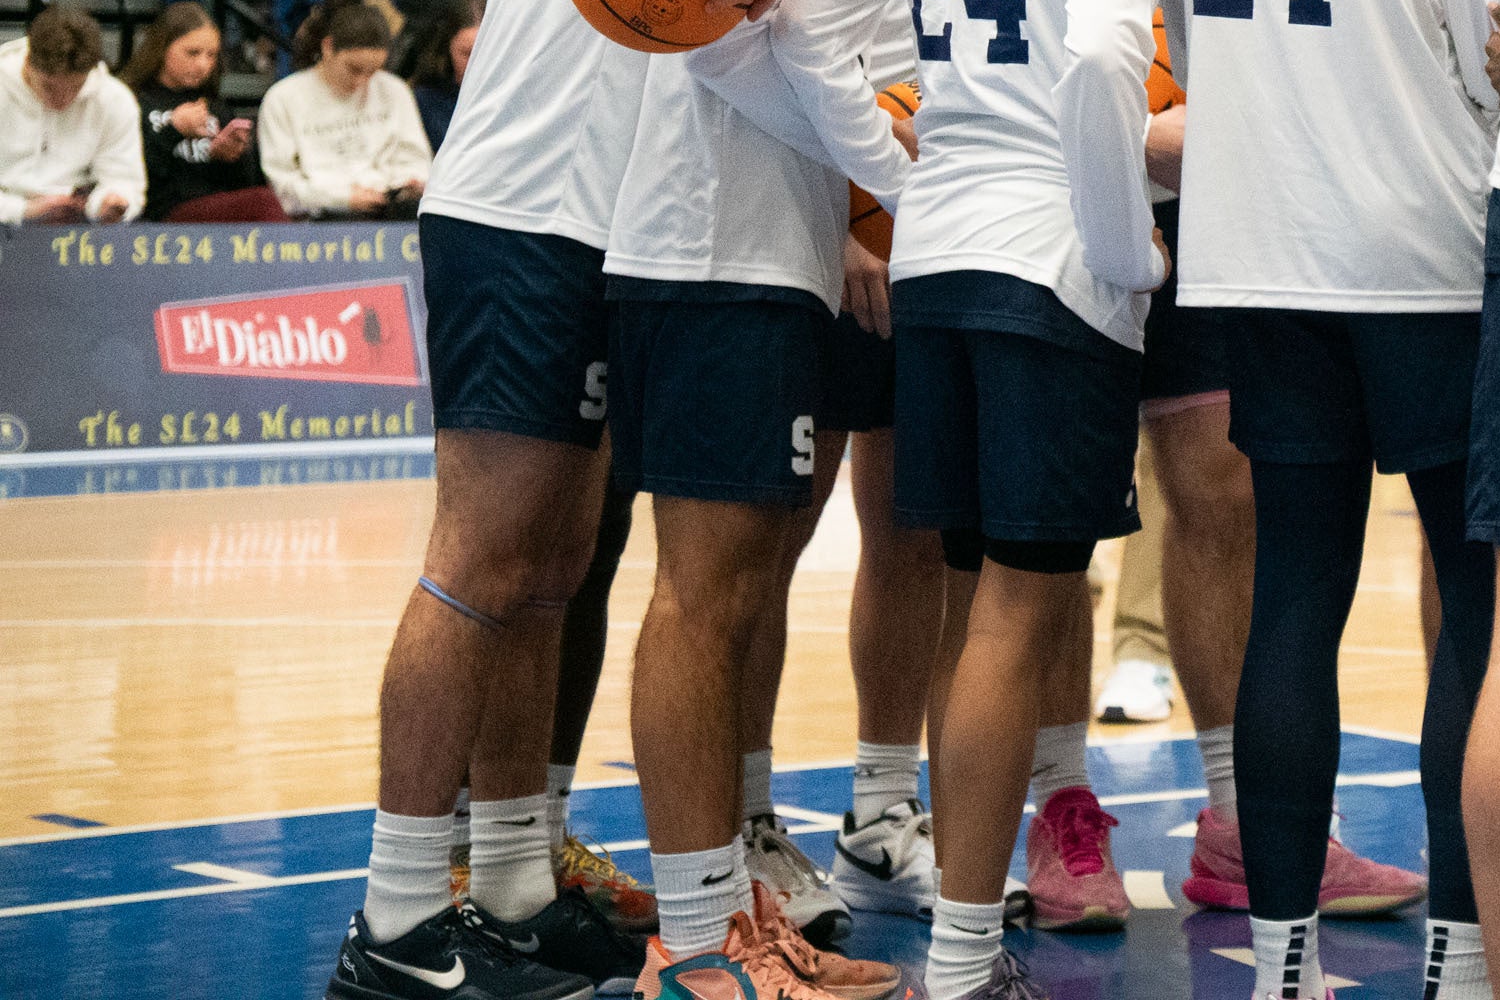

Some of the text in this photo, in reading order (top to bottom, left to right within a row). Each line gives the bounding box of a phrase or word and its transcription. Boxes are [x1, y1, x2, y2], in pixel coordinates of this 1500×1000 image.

[52, 231, 114, 266] The
[230, 228, 385, 263] Memorial
[181, 309, 213, 354] El
[78, 410, 142, 447] The
[258, 400, 415, 440] Memorial
